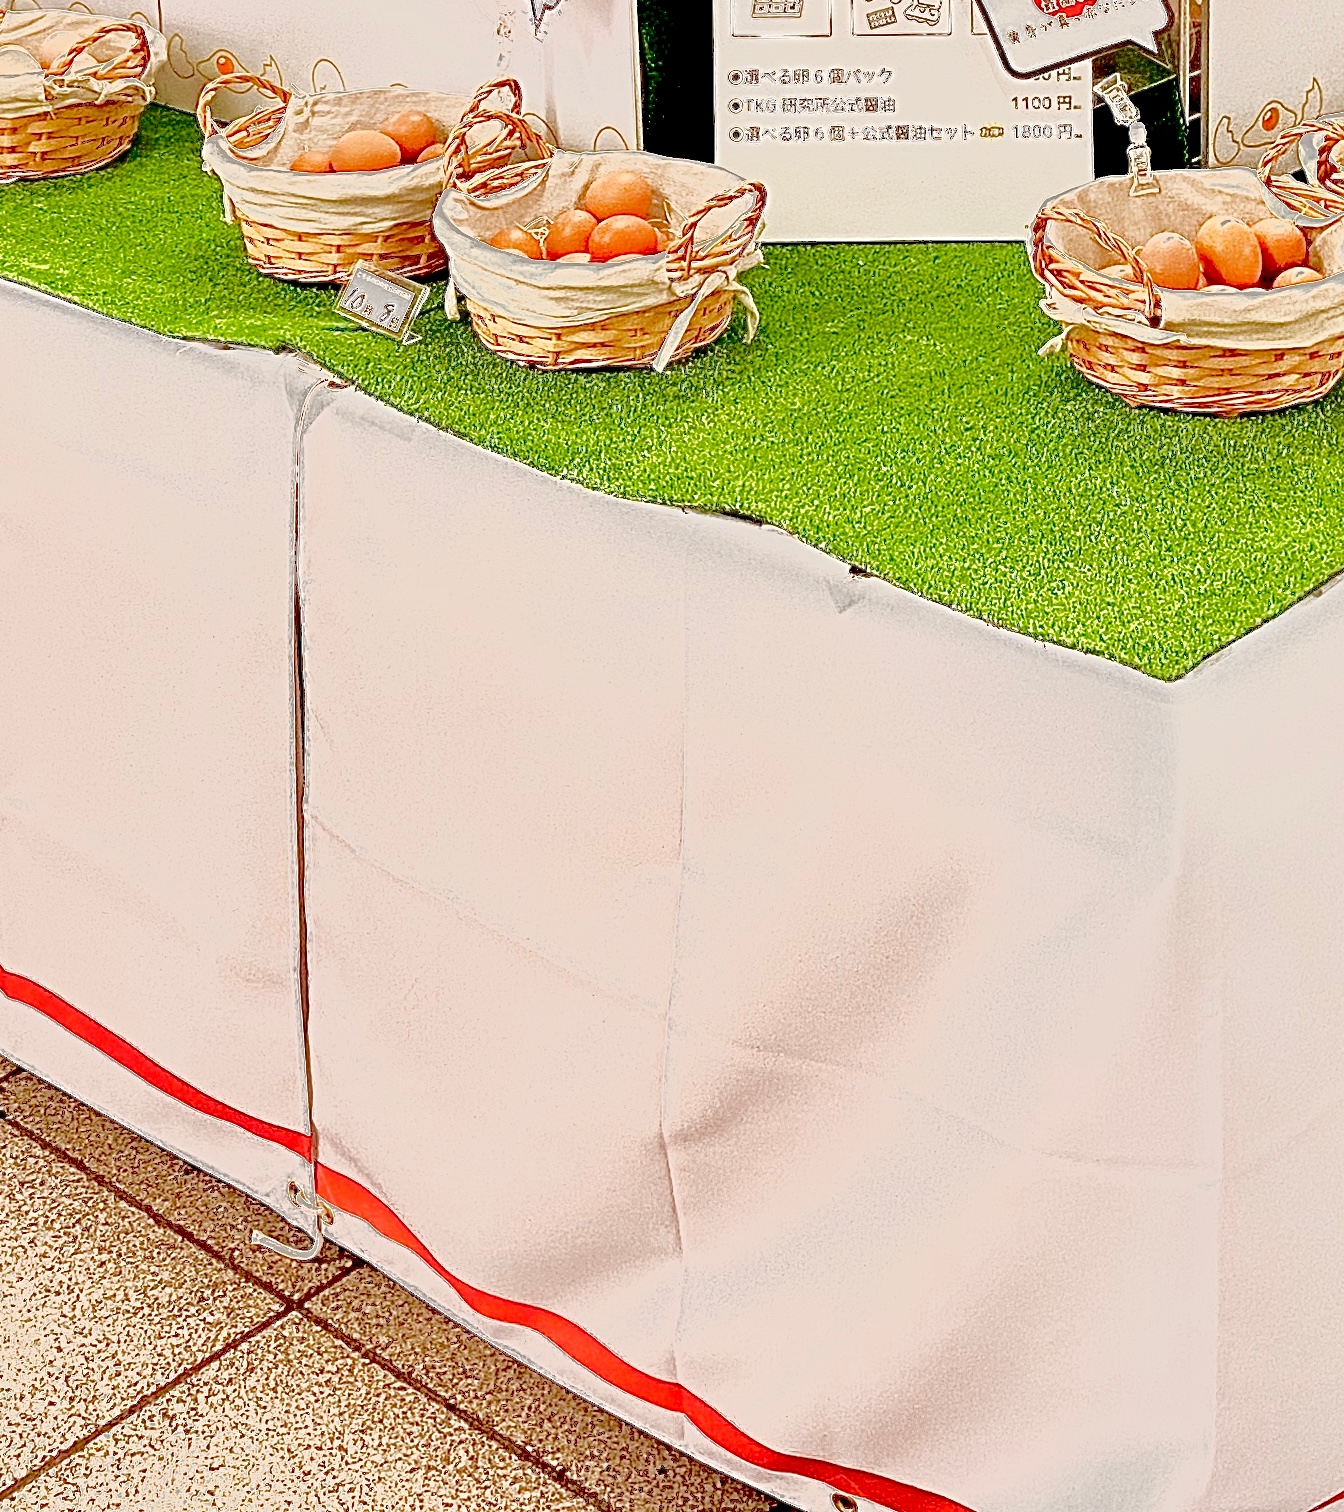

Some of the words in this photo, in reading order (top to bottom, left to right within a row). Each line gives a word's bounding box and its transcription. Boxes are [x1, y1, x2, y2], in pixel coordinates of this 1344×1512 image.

[743, 98, 777, 114] TKG
[782, 96, 897, 115] 研究所公式醤油
